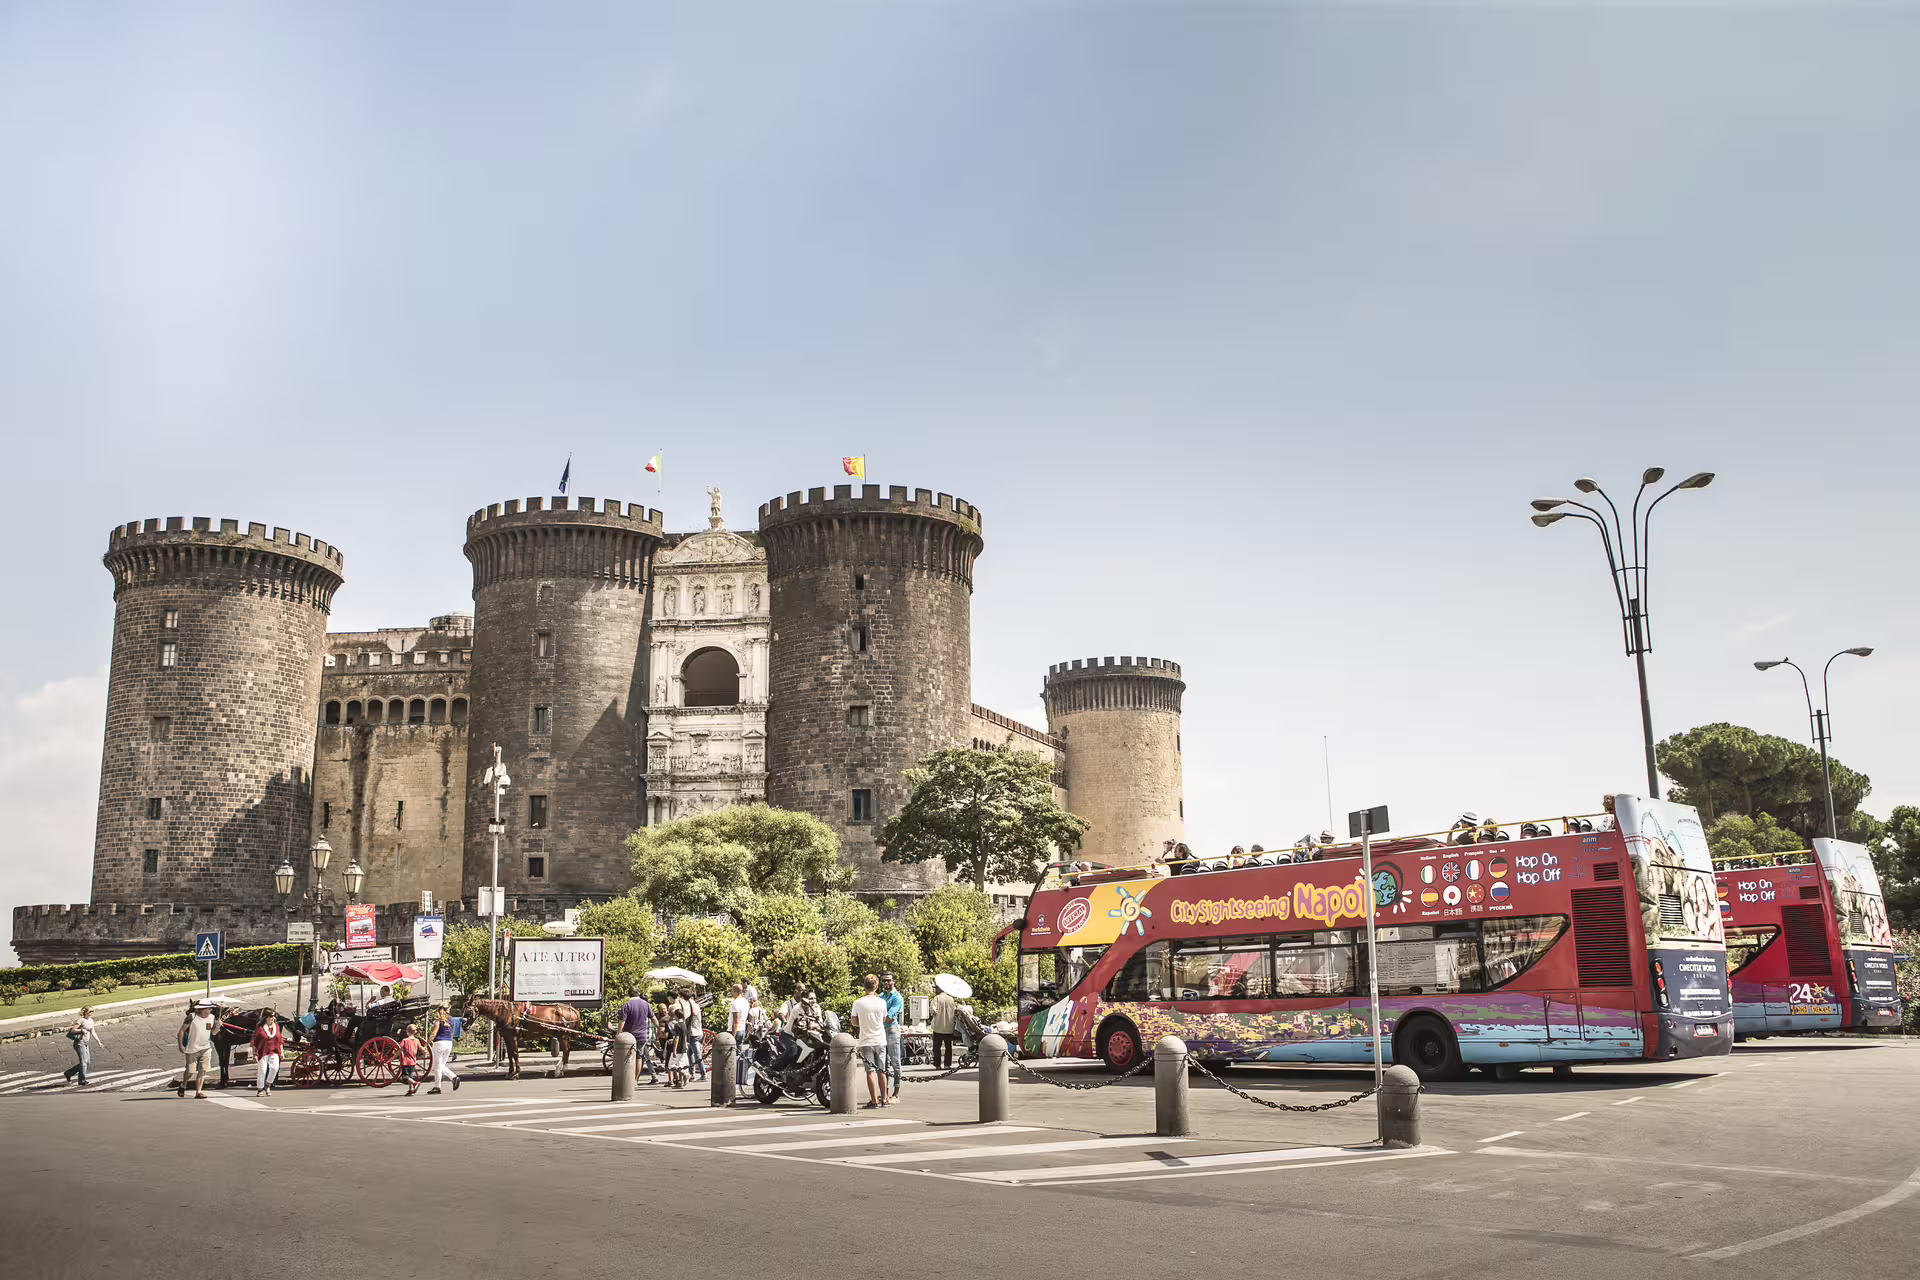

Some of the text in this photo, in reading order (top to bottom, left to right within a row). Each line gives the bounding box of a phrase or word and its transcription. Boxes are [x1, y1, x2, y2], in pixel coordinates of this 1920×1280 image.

[1515, 856, 1538, 868] Hop
[1541, 852, 1558, 866] On
[1517, 871, 1540, 885] Hop
[1542, 868, 1561, 882] Off
[1738, 879, 1773, 890] Hop On
[1171, 880, 1376, 927] CitySightseeing Napol
[1740, 890, 1776, 902] Hop Off
[519, 952, 596, 962] A TE ALTRO
[1789, 983, 1813, 1004] 24
